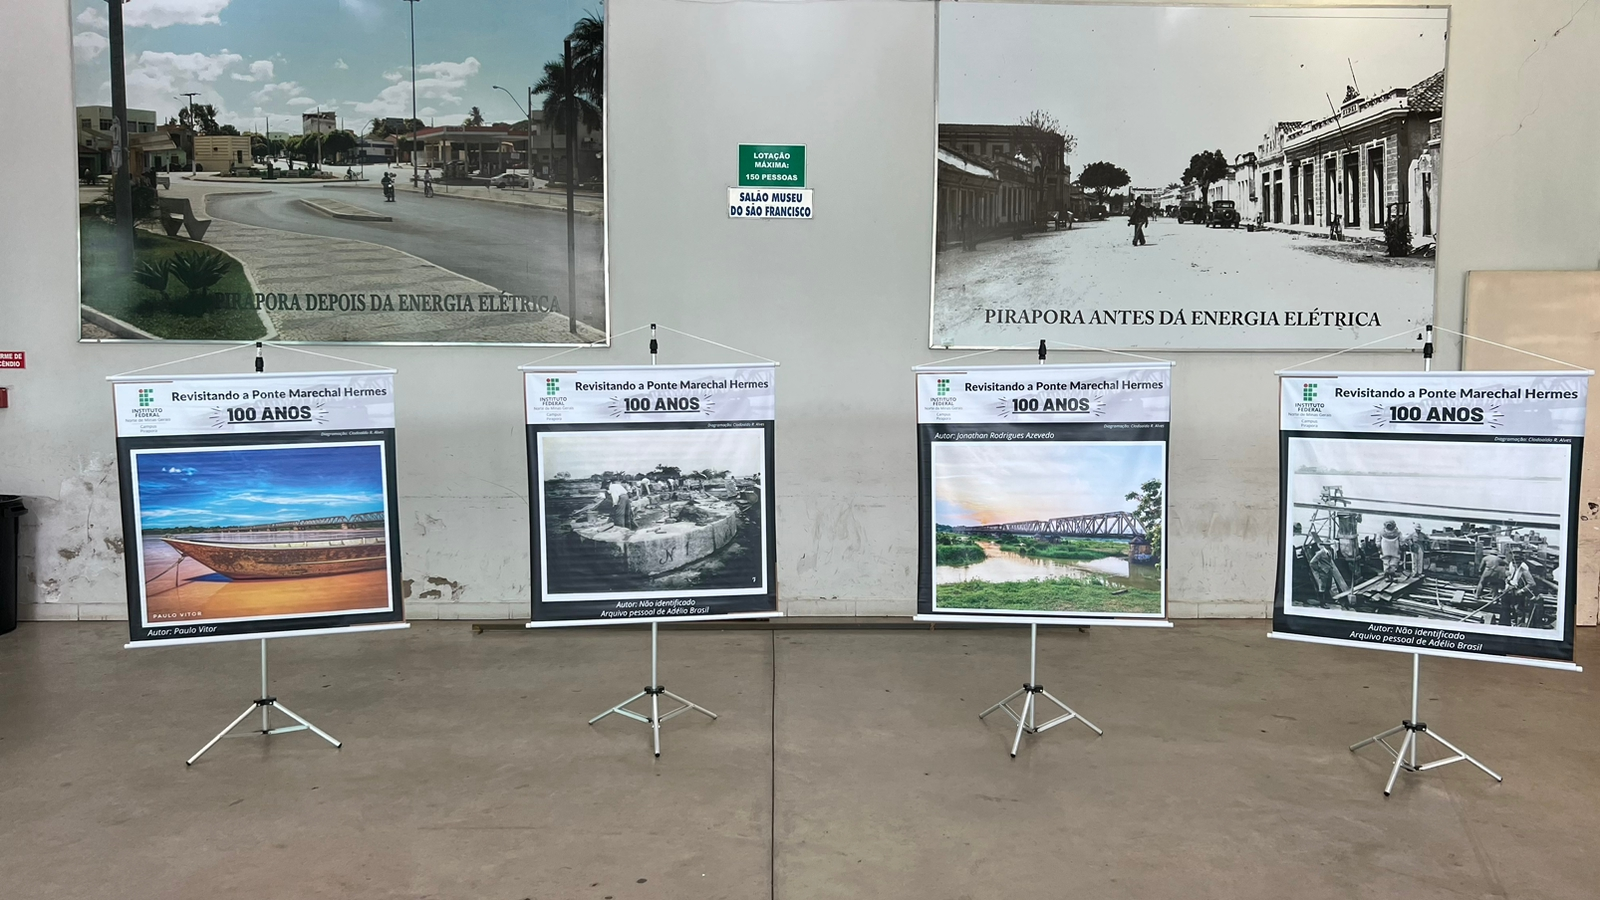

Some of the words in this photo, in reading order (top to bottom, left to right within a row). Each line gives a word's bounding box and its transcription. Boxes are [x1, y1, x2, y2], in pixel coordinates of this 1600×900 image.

[753, 152, 790, 160] LOTAÇÃO
[740, 189, 769, 202] SALÃO
[771, 192, 802, 202] MUSEU
[731, 205, 743, 216] DO
[746, 203, 762, 216] SÃO
[765, 206, 811, 217] FRANCISCO
[215, 293, 302, 310] PIRAPORA
[305, 294, 365, 311] DEPOIS
[370, 294, 395, 312] DA
[398, 294, 475, 312] ENERGIA
[478, 291, 562, 313] ELÉTRICA
[984, 309, 1085, 324] PIRAPORA
[1088, 310, 1155, 325] ANTES
[1158, 309, 1187, 325] DÁ
[1191, 311, 1280, 326] ENERGIA
[1284, 308, 1381, 327] ELÉTRICA
[575, 381, 636, 391] Revisitando
[647, 381, 677, 390] Ponte
[680, 380, 727, 390] Marechal
[730, 379, 769, 389] Hermes
[965, 382, 1025, 392] Revisitando
[1036, 381, 1067, 391] Ponte
[1070, 380, 1119, 390] Marechal
[1122, 380, 1163, 390] Hermes
[172, 390, 239, 402] Revisitando
[252, 389, 286, 400] Ponte
[289, 387, 341, 399] Marechal
[344, 387, 387, 397] Hermes
[1335, 387, 1405, 398] Revisitando
[1419, 389, 1456, 398] Ponte
[1460, 388, 1521, 399] Marechal
[1525, 389, 1578, 400] Hermes
[624, 398, 650, 411] 100
[654, 397, 700, 410] ANOS
[1012, 398, 1039, 412] 100
[1043, 397, 1090, 411] ANOS
[227, 407, 256, 422] 100
[261, 406, 312, 421] ANOS
[1389, 406, 1421, 421] 100
[1426, 407, 1484, 422] ANOS
[956, 432, 988, 440] Jonathan
[990, 432, 1024, 441] Rodrigues
[655, 599, 696, 607] identificado
[601, 609, 628, 618] Arquivo
[629, 609, 655, 617] pessoal
[666, 607, 688, 615] Adélio
[689, 606, 709, 614] Brasil
[147, 629, 172, 637] Autor:
[174, 627, 196, 635] Paulo
[1368, 623, 1393, 633] Autor:
[1395, 626, 1413, 635] Não
[1414, 628, 1465, 640] identificado
[1350, 630, 1381, 641] Arquivo
[1382, 634, 1414, 644] pessoal
[1416, 637, 1427, 645] de
[1428, 638, 1455, 649] Adélio
[1457, 642, 1482, 651] Brasil
